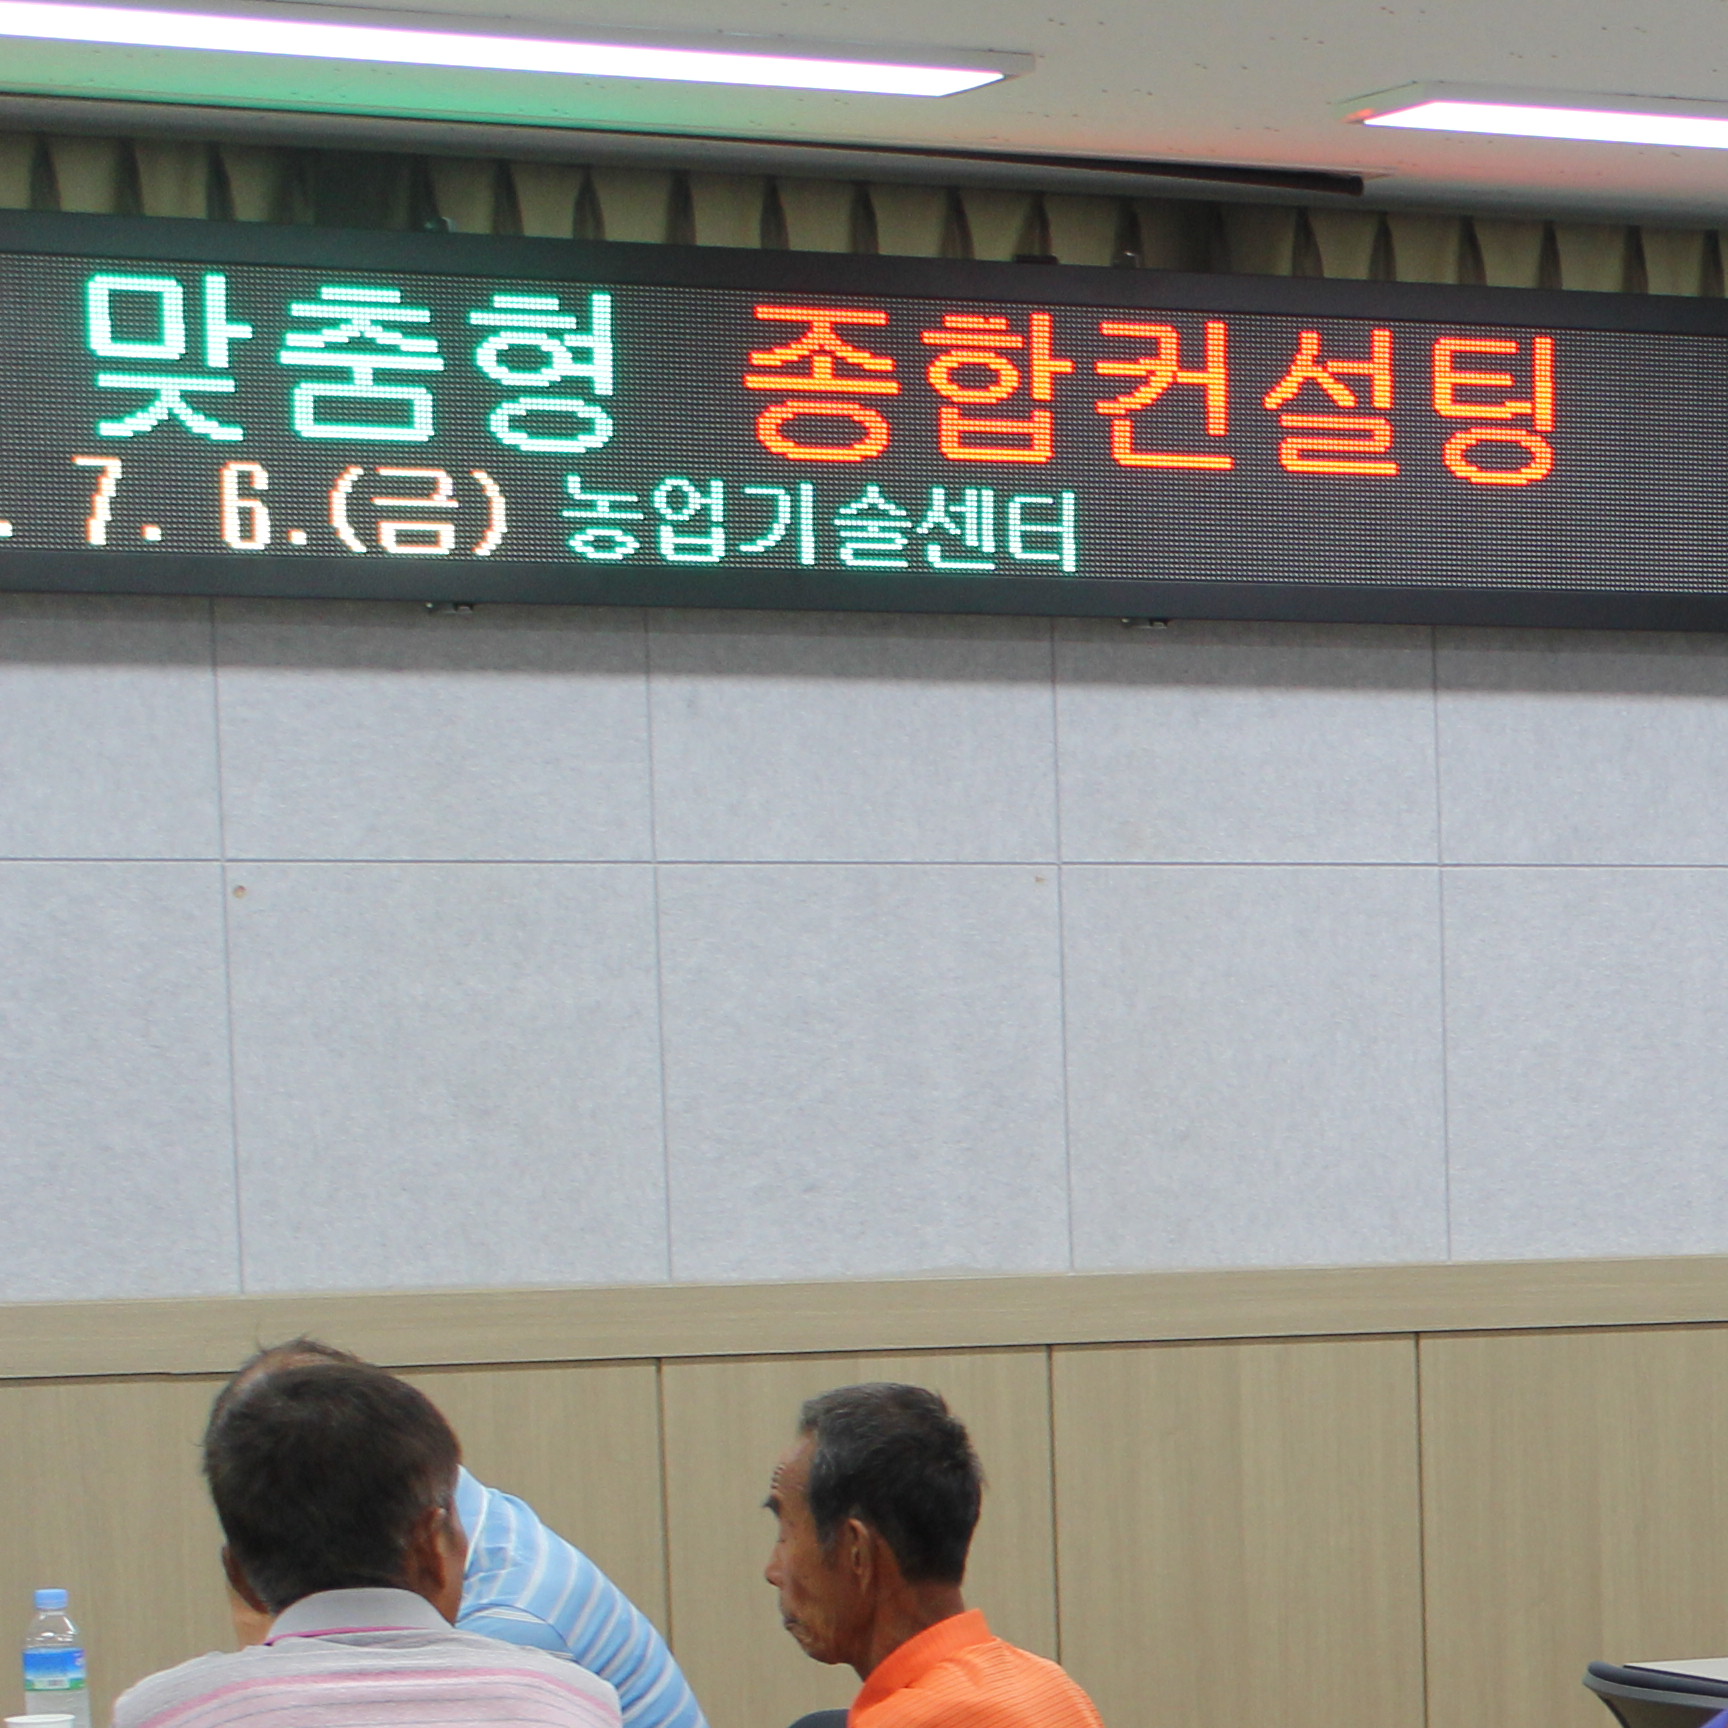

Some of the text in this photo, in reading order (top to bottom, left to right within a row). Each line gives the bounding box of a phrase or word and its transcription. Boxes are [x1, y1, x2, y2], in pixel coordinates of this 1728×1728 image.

[86, 273, 1556, 485] 맞춤형 종합컨설팅
[560, 473, 1077, 572] 농업기술센터
